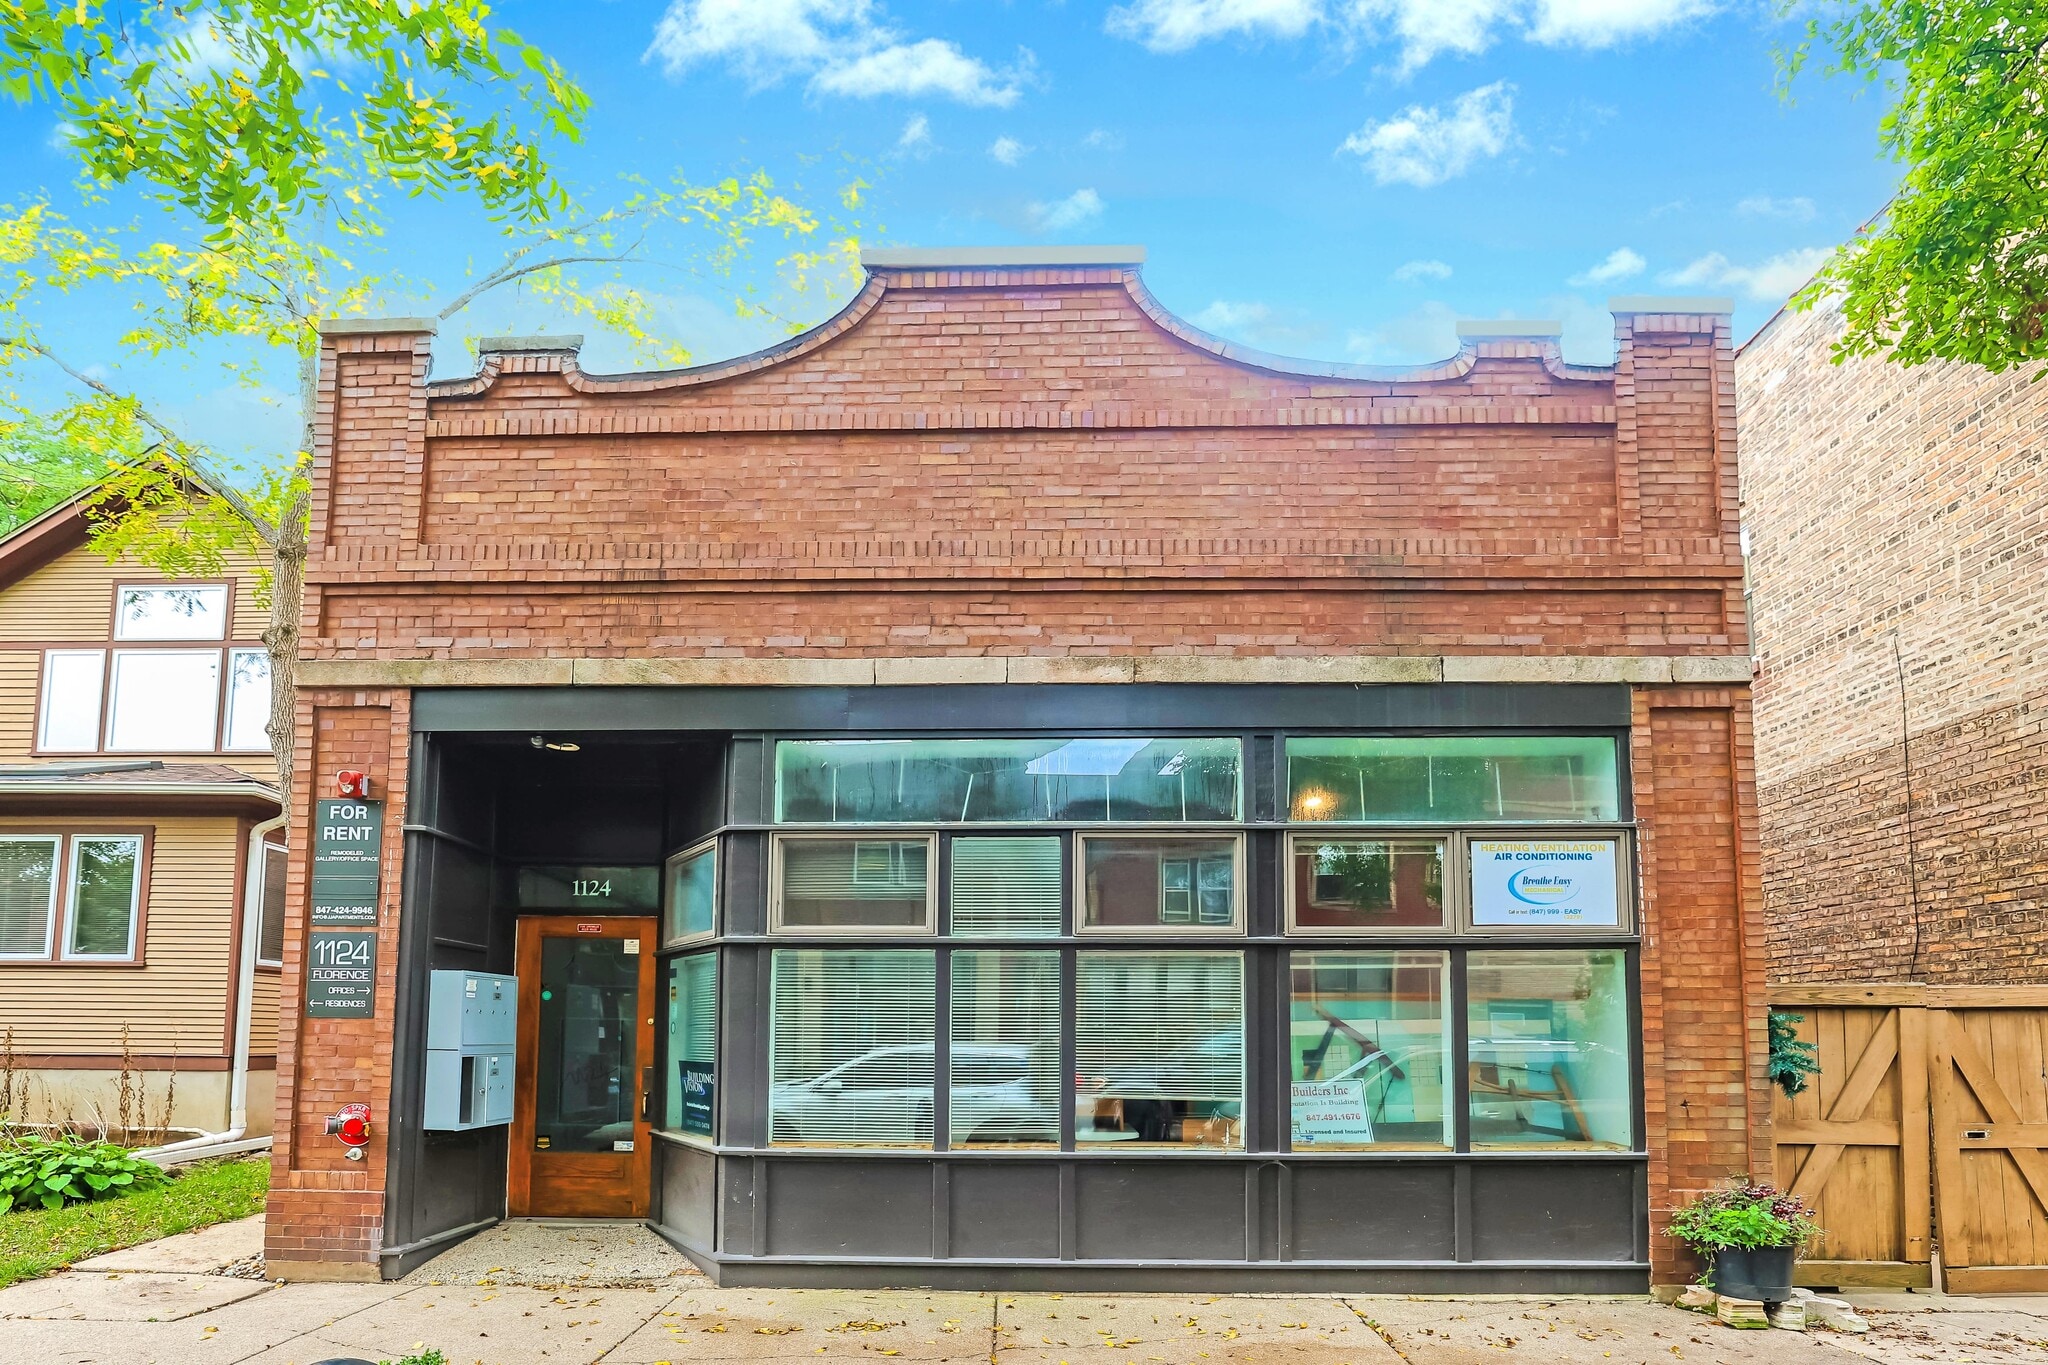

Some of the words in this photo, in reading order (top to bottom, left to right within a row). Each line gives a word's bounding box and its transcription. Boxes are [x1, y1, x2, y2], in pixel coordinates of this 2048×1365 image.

[329, 805, 368, 820] FOR
[323, 826, 373, 841] RENT
[1480, 844, 1530, 852] HEATING
[1533, 844, 1606, 852] VENTILATION
[1494, 853, 1513, 861] AIR
[1515, 853, 1593, 861] CONDITIONING
[1522, 876, 1552, 885] Breathe
[1553, 876, 1573, 888] Easy
[572, 880, 612, 897] 1124
[315, 906, 373, 915] 847-424-9946
[314, 940, 370, 965] 1124
[313, 970, 369, 979] FLORENCE
[328, 986, 355, 994] OFFICES
[325, 1000, 366, 1008] RESIDENCES
[687, 1070, 715, 1084] BUILDING
[1292, 1086, 1331, 1097] Builders
[1333, 1084, 1349, 1096] Inc
[1306, 1112, 1361, 1121] 847.491.1676
